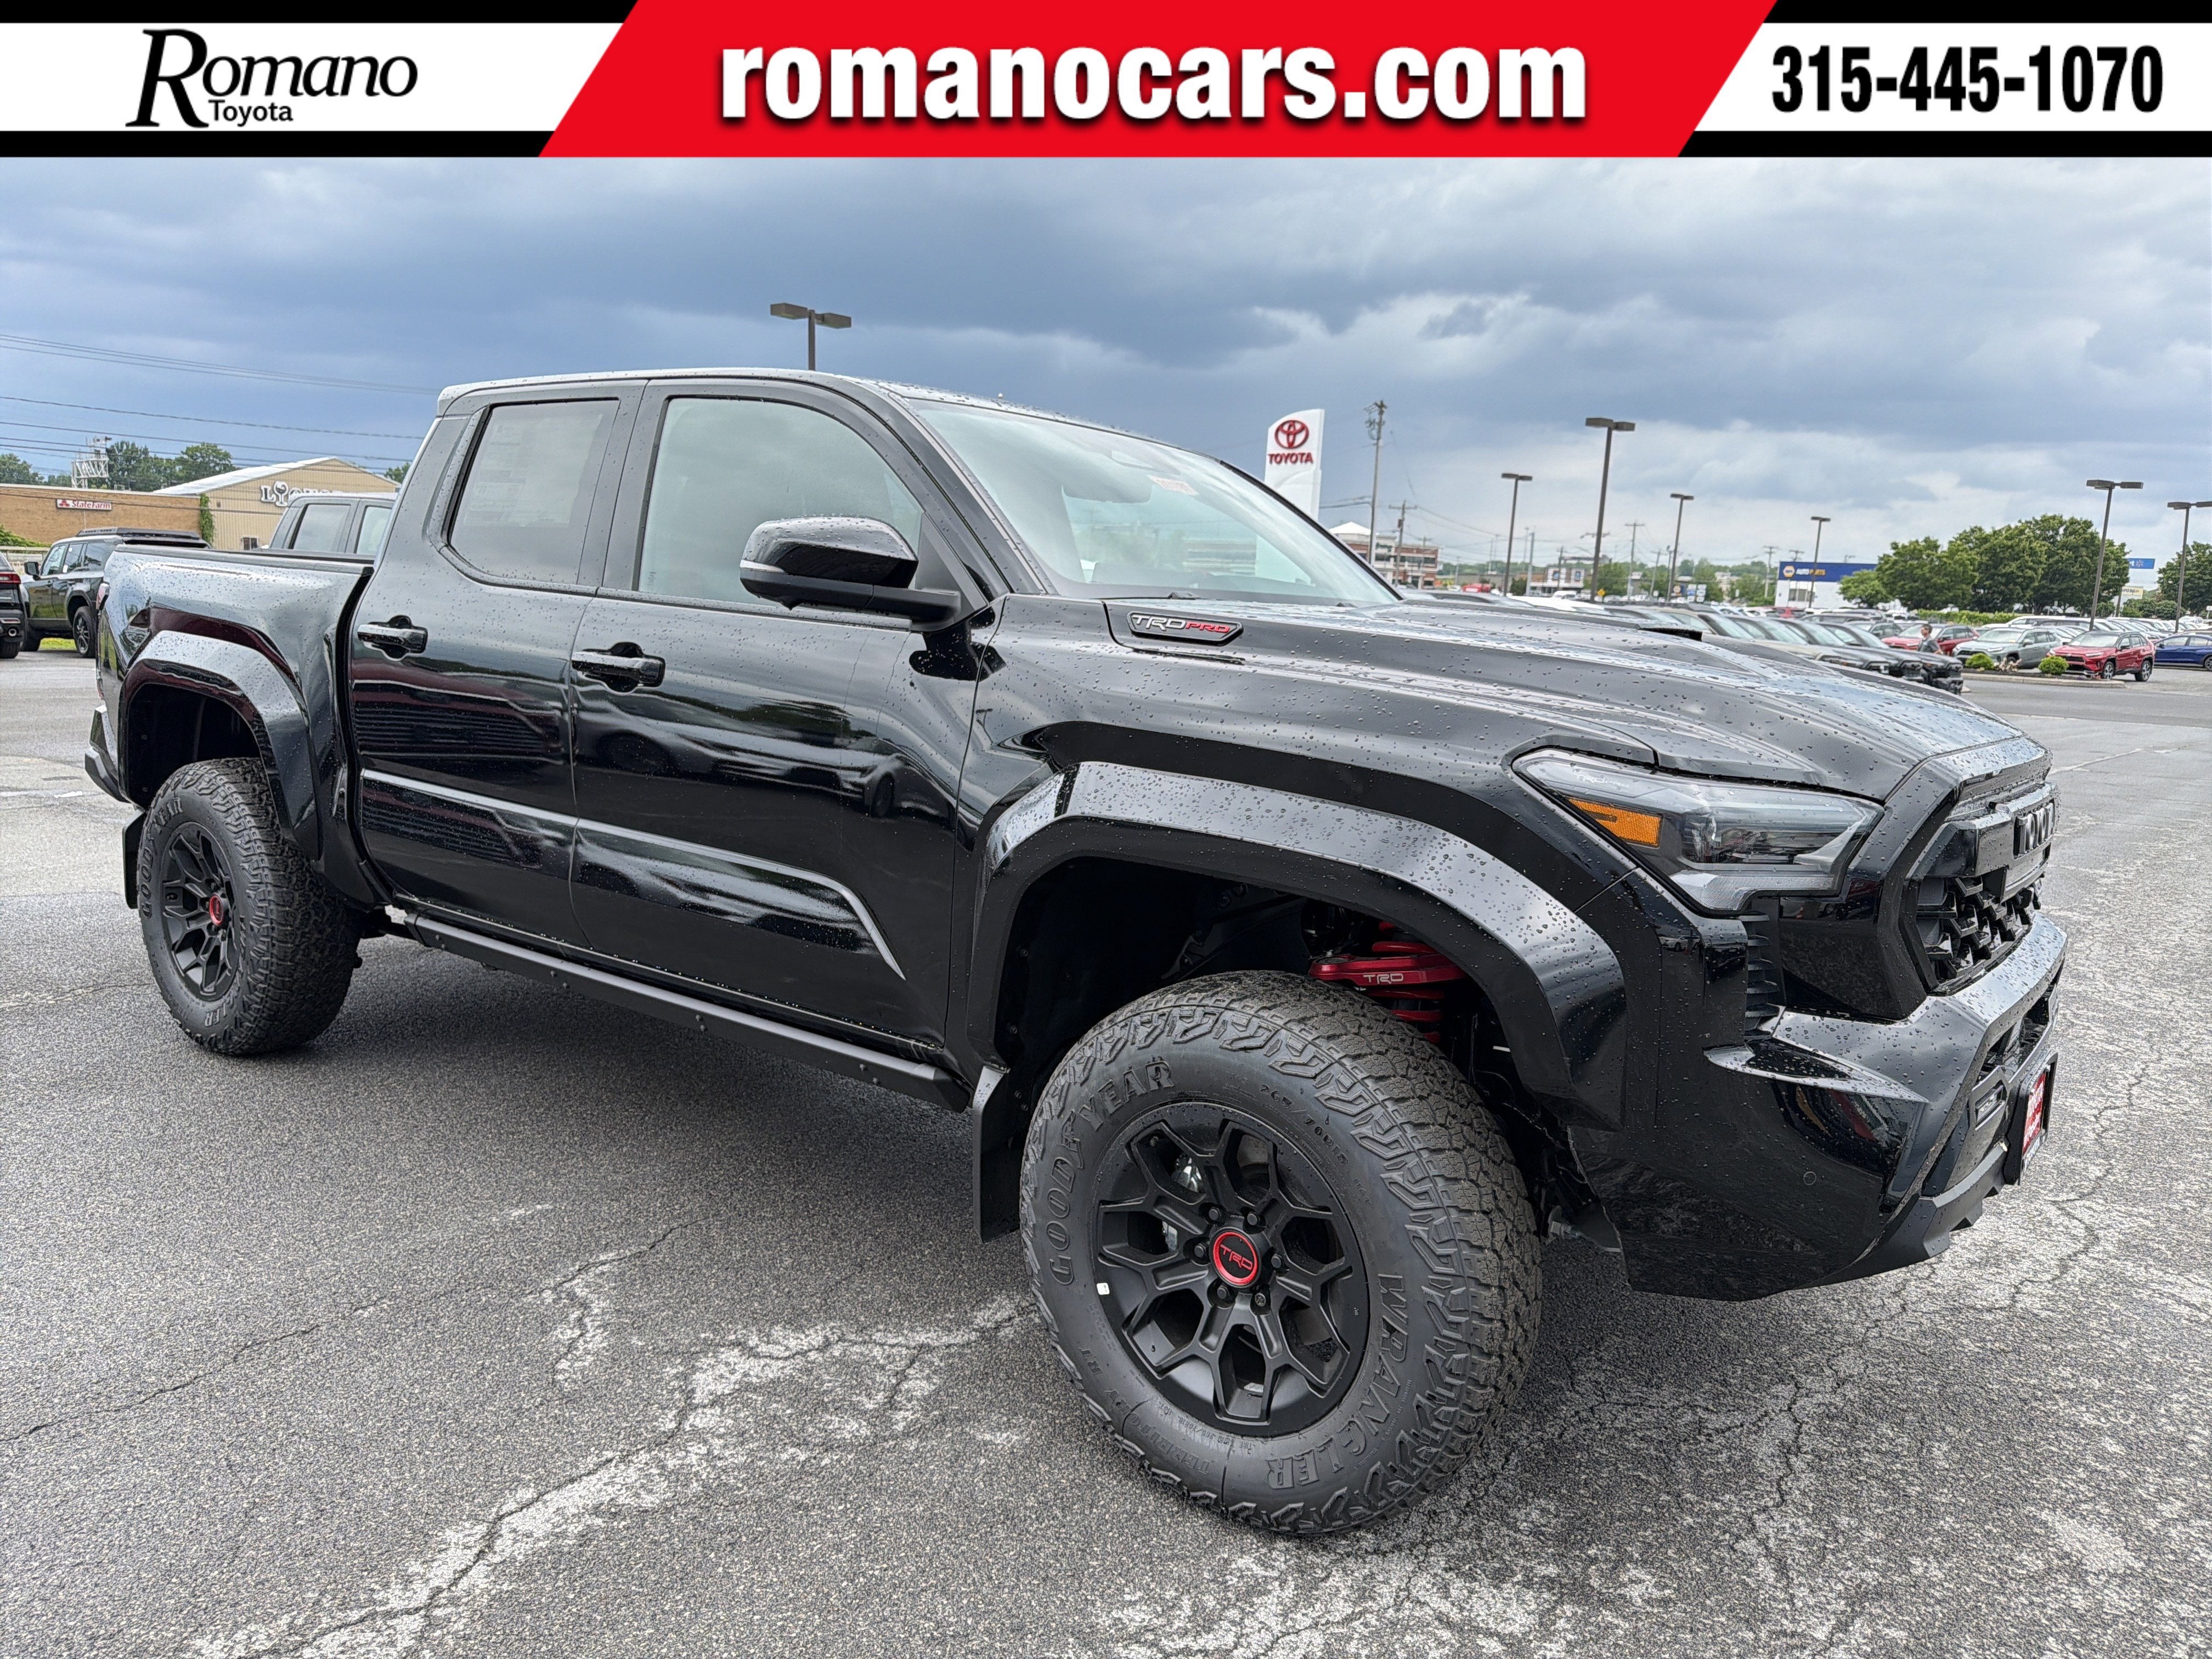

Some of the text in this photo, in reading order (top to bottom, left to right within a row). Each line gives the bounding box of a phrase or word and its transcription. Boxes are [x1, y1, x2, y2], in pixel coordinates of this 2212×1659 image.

[1268, 452, 1313, 464] TOYOTA
[1132, 614, 1230, 633] TRD PRO
[1363, 973, 1404, 985] TRD
[1220, 1244, 1253, 1271] TRD
[1267, 1273, 1409, 1490] WRANGLER
